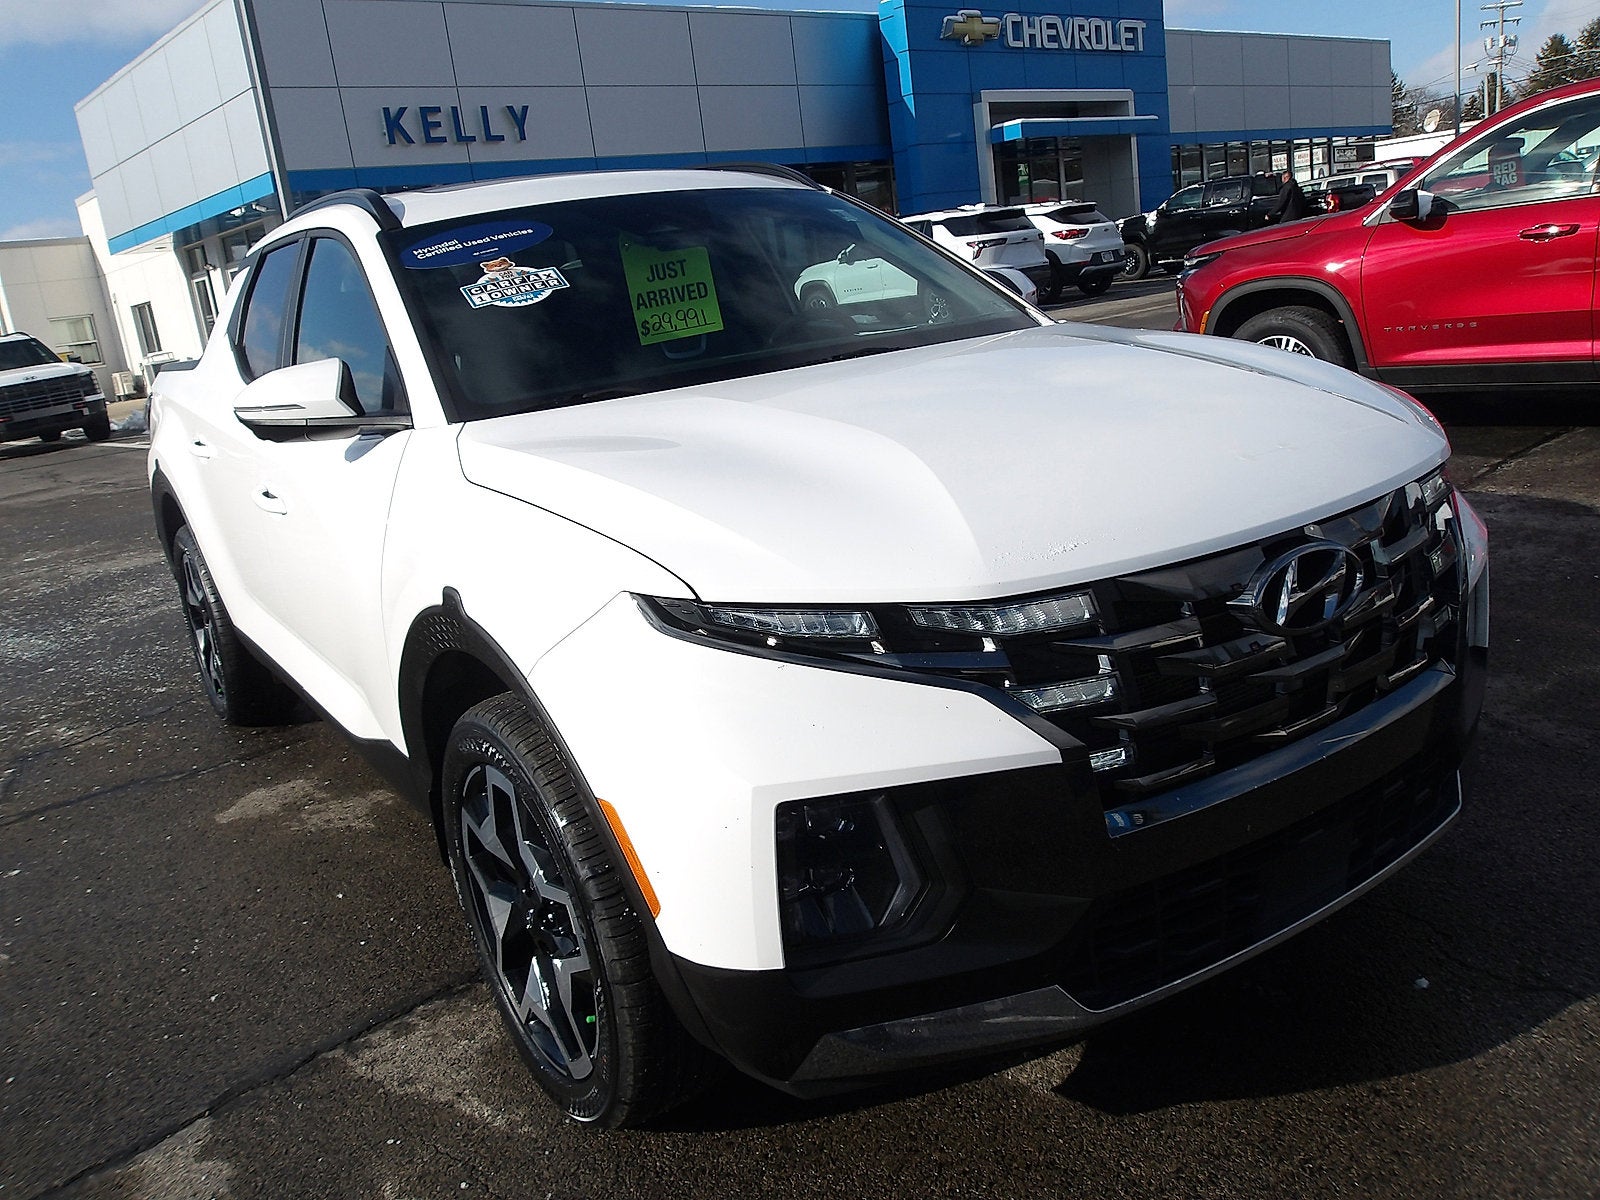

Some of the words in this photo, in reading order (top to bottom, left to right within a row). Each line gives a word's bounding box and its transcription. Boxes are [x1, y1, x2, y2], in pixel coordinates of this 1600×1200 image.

[1004, 13, 1146, 51] CHEVROLET
[382, 104, 530, 145] KELLY
[1493, 161, 1517, 175] RED
[1494, 172, 1518, 186] TAG
[412, 240, 458, 256] Hyundai
[417, 243, 464, 260] Certified
[463, 236, 491, 248] Used
[490, 228, 534, 241] Vehicles
[646, 259, 687, 282] JUST
[471, 272, 553, 294] CARFAX
[476, 294, 486, 303] 1
[490, 279, 560, 299] OWNER
[636, 282, 709, 310] ARRIVED
[1384, 321, 1478, 332] TRAVERSE
